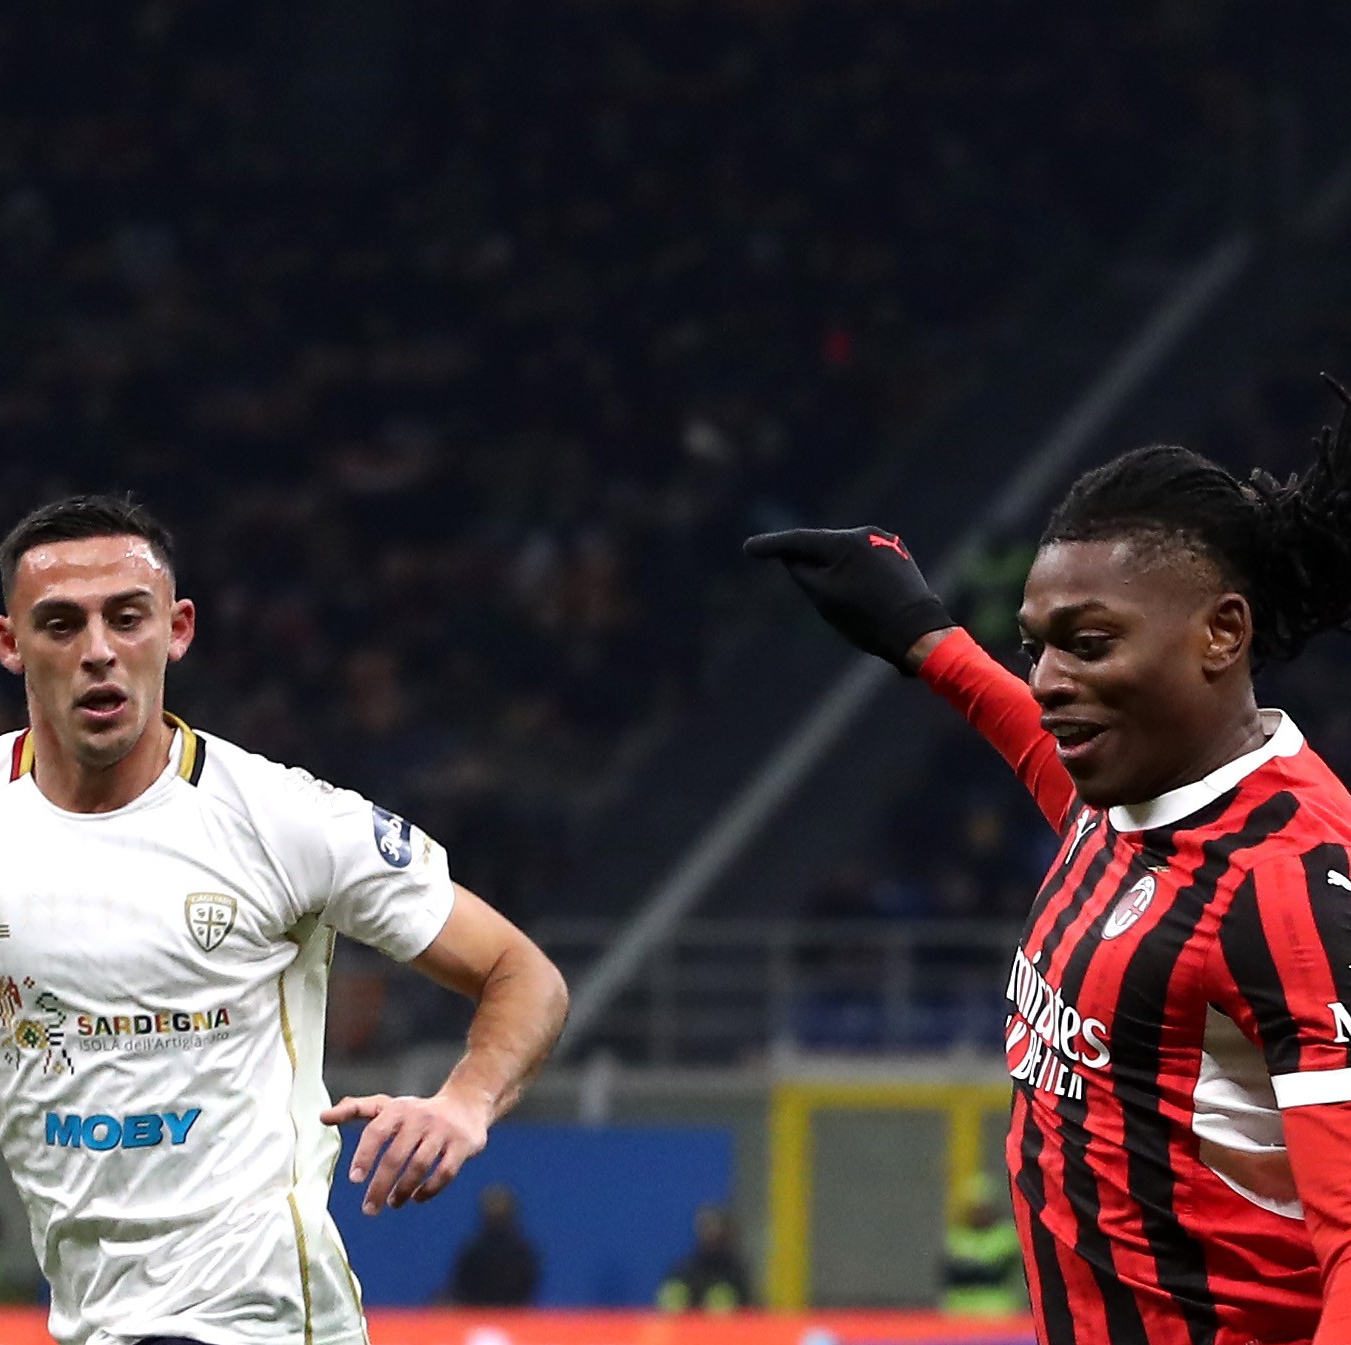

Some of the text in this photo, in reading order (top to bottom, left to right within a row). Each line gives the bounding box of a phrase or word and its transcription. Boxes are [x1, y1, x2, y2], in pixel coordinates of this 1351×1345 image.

[77, 1008, 230, 1036] SARDEGNA
[1006, 944, 1111, 1069] mirates
[45, 1108, 201, 1151] MOBY
